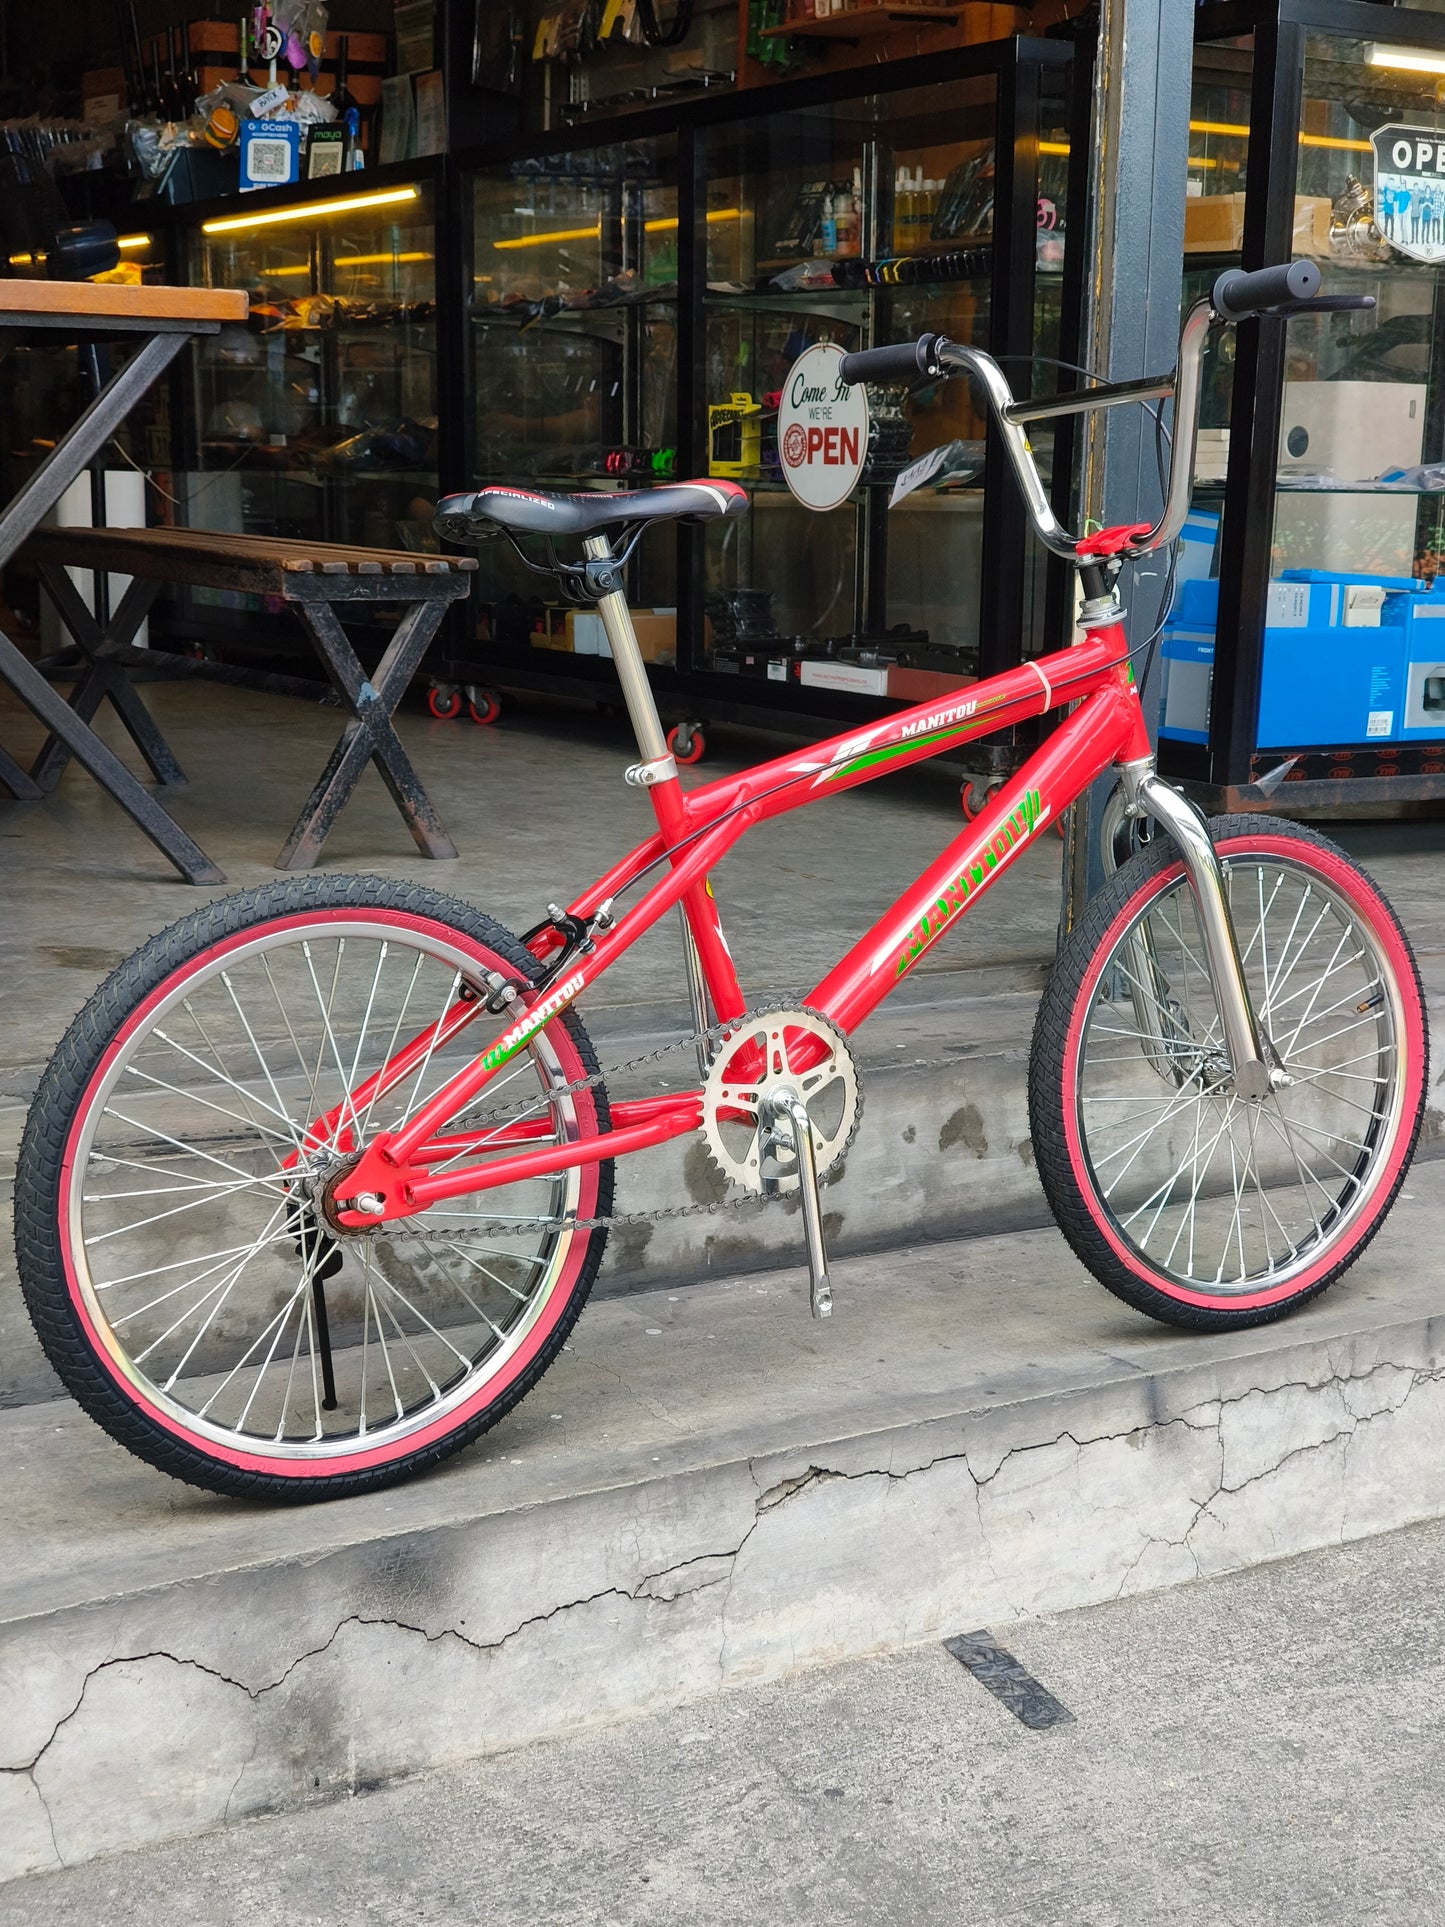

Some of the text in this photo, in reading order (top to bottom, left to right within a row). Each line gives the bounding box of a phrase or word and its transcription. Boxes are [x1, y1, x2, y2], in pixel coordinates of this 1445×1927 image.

[261, 123, 293, 132] GCash
[314, 130, 342, 140] maya
[791, 373, 850, 409] Come In
[809, 407, 833, 420] WE'RE
[478, 490, 555, 510] SPECIALIZED
[901, 700, 978, 738] MANITOU
[502, 972, 585, 1052] MANITOU
